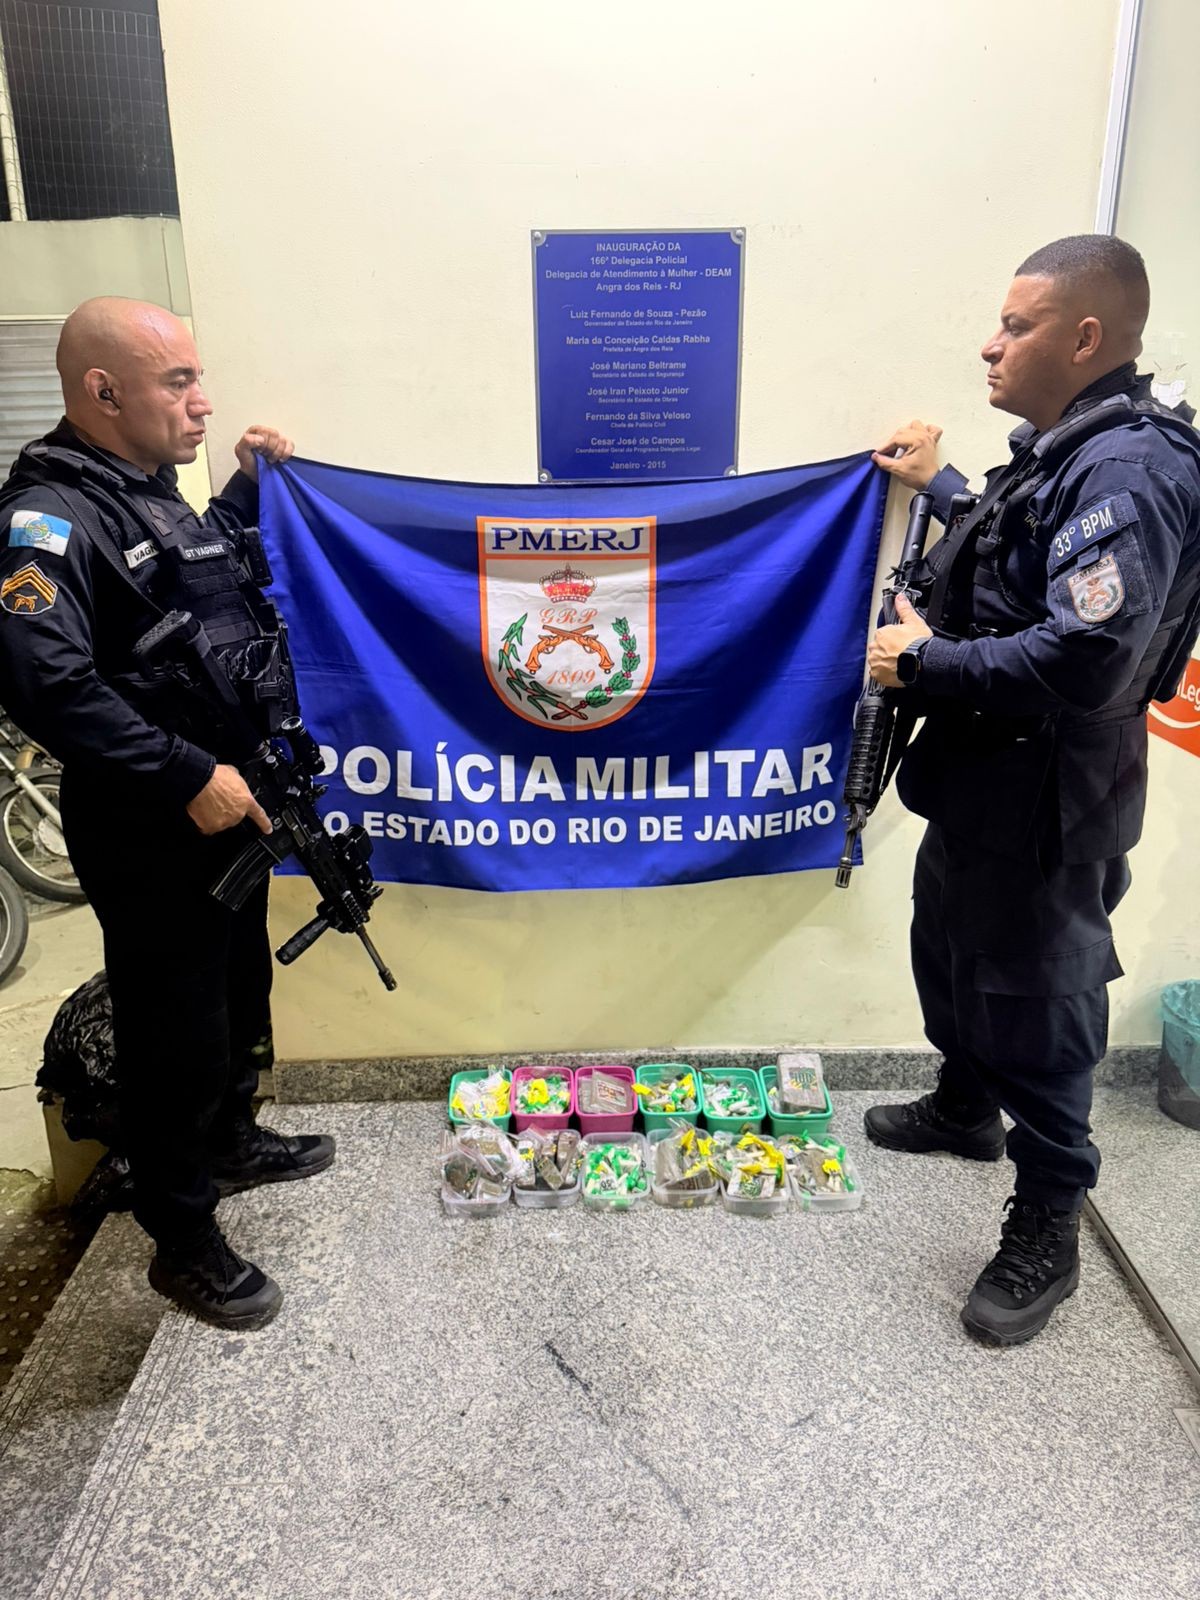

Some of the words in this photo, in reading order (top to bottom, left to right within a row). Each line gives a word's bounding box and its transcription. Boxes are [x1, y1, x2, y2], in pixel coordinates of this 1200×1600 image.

[596, 241, 666, 253] INAUGURAÇÃO
[668, 242, 682, 251] DA
[611, 256, 653, 266] Delegacia
[656, 255, 688, 264] Policial
[546, 270, 588, 280] Delegacia
[590, 270, 600, 278] de
[603, 269, 658, 278] Atendimento
[668, 268, 698, 277] Mulher
[705, 268, 732, 277] DEAM
[596, 284, 622, 293] Angra
[624, 283, 640, 291] dos
[644, 282, 662, 290] Reis
[670, 282, 682, 290] RJ
[570, 310, 588, 318] Luiz
[590, 310, 632, 318] Fernando
[634, 310, 644, 318] de
[647, 310, 673, 318] Souza
[680, 308, 707, 318] Pezão
[566, 336, 590, 344] Maria
[592, 336, 602, 344] da
[604, 336, 650, 345] Conceição
[652, 335, 680, 344] Caldas
[683, 335, 710, 343] Rabha
[590, 362, 610, 371] José
[612, 361, 646, 370] Mariano
[649, 361, 686, 369] Beltrame
[587, 387, 608, 396] José
[610, 387, 626, 395] Iran
[628, 387, 660, 395] Peixoto
[662, 386, 689, 395] Junior
[585, 412, 626, 421] Fernando
[627, 412, 638, 420] da
[640, 412, 661, 420] Silva
[662, 411, 691, 420] Veloso
[591, 437, 616, 446] Cesar
[617, 437, 637, 446] José
[639, 437, 650, 445] de
[652, 436, 685, 446] Campos
[610, 461, 640, 470] Janeiro
[647, 461, 667, 469] 2015
[1081, 506, 1114, 539] BPM
[491, 527, 644, 551] PMERJ
[194, 544, 225, 556] VAGNER
[539, 608, 598, 624] GRP
[546, 670, 596, 685] 1809
[576, 742, 833, 801] MILITAR
[324, 811, 350, 838] O
[363, 811, 499, 847] ESTADO
[510, 818, 556, 846] DO
[568, 816, 627, 844] RIO
[640, 816, 683, 843] DE
[694, 800, 836, 842] JANEIRO
